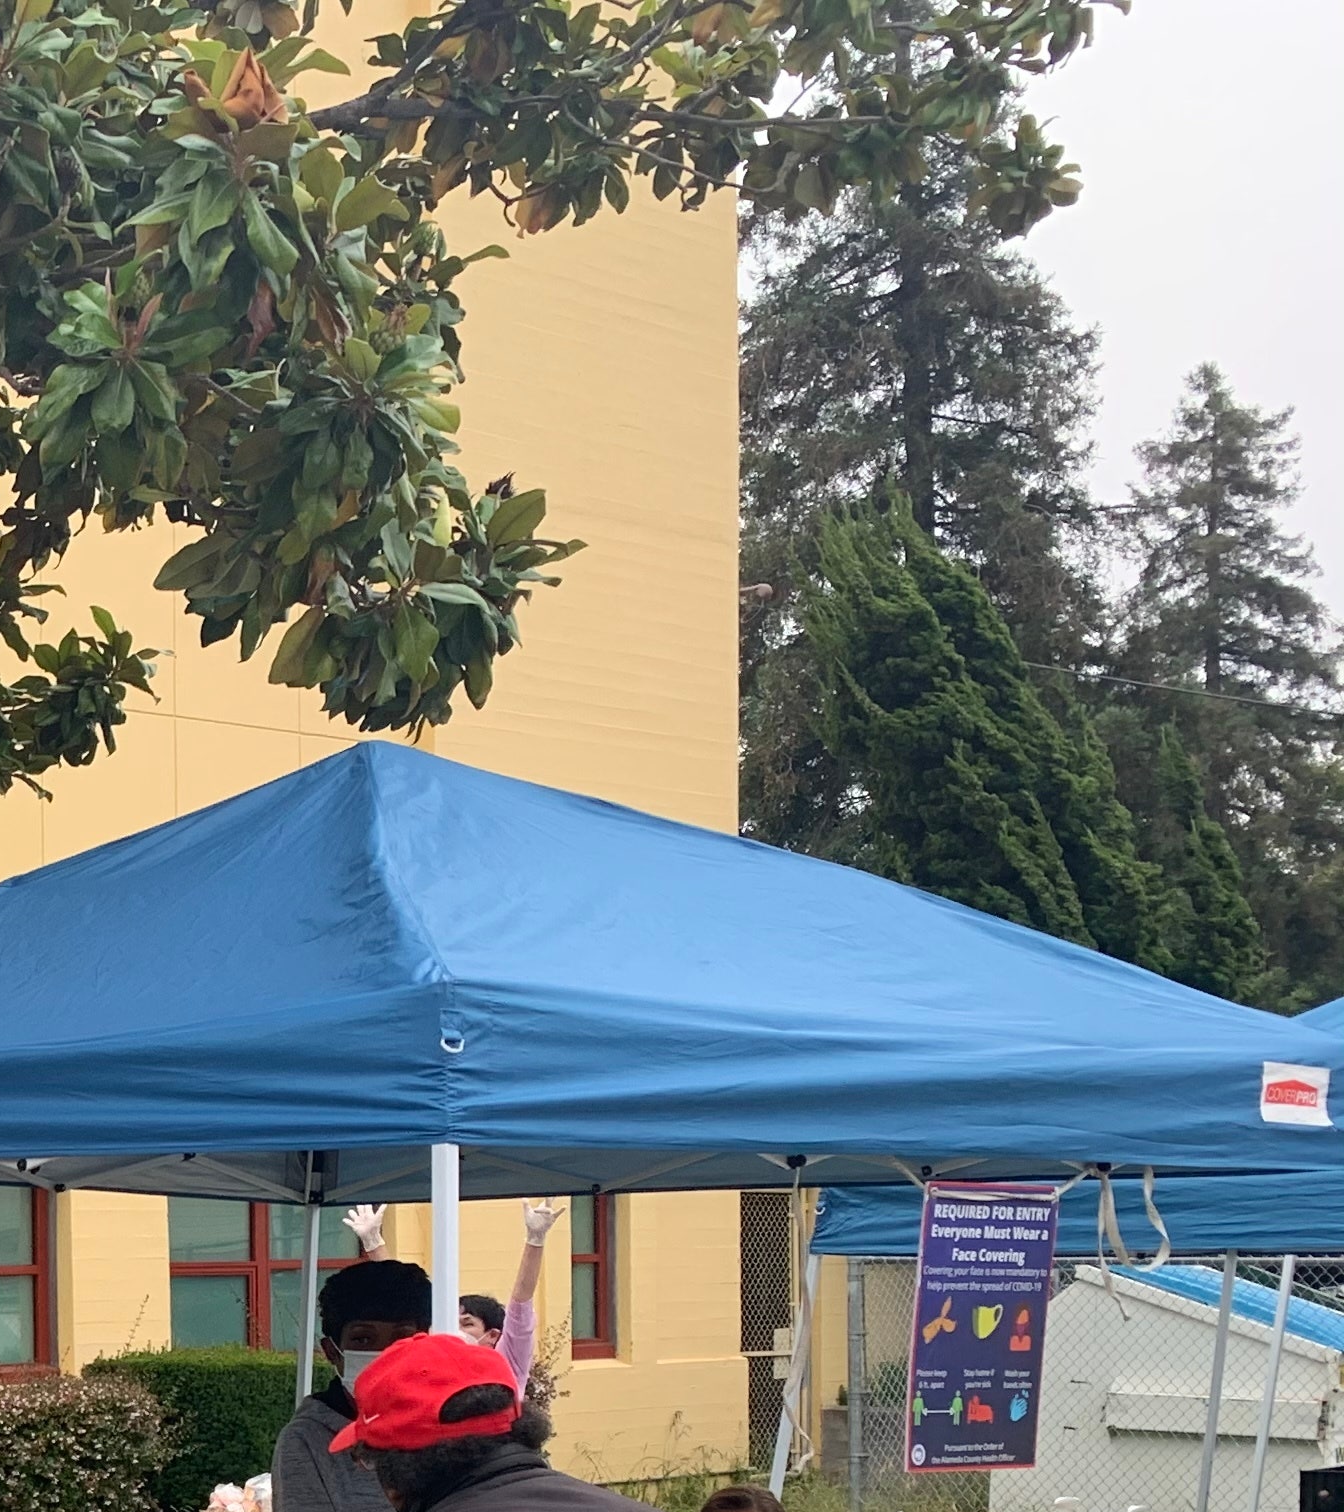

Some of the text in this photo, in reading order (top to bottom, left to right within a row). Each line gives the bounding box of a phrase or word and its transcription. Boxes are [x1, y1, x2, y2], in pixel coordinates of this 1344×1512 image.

[934, 1204, 1051, 1221] REQUIRED FOR ENTRY
[931, 1224, 1049, 1242] Everyone Must Wear a
[952, 1248, 1025, 1266] Face Covering
